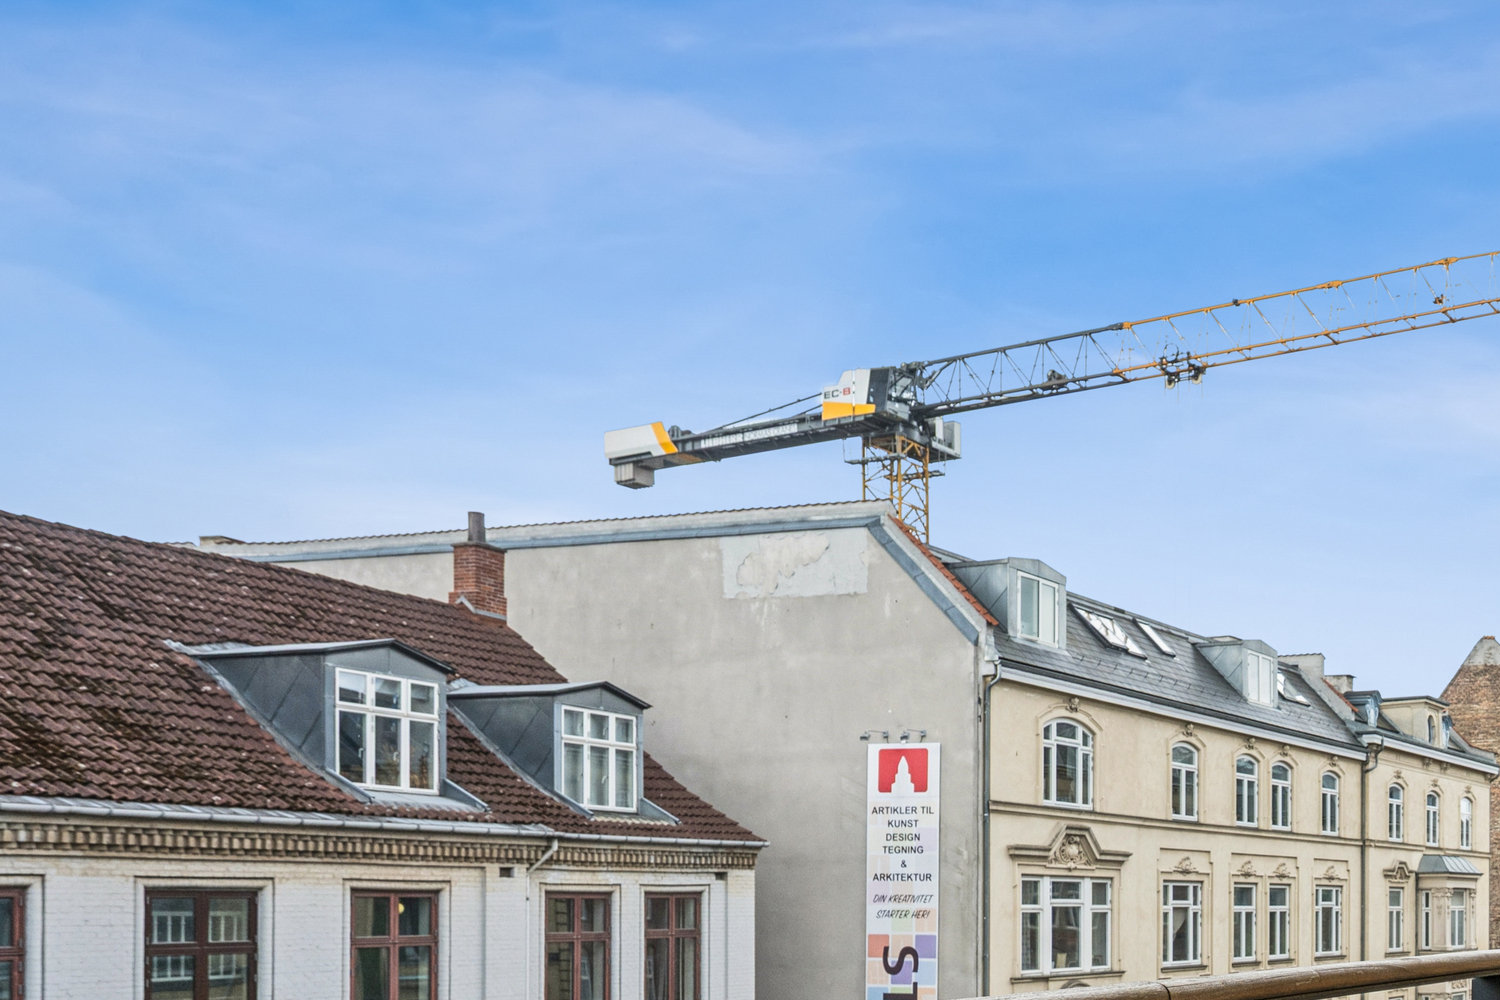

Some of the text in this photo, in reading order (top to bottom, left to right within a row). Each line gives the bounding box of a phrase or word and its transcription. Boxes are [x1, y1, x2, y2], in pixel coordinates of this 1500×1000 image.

[871, 806, 935, 815] ARTIKLER TIL
[887, 819, 919, 828] KUNST
[885, 833, 921, 842] DESIGN
[882, 845, 924, 854] TEGNING
[900, 859, 907, 868] &
[872, 873, 933, 882] ARKITEKTUR
[872, 894, 934, 903] DIN KREATIVITET
[875, 909, 931, 919] STARTER HER!
